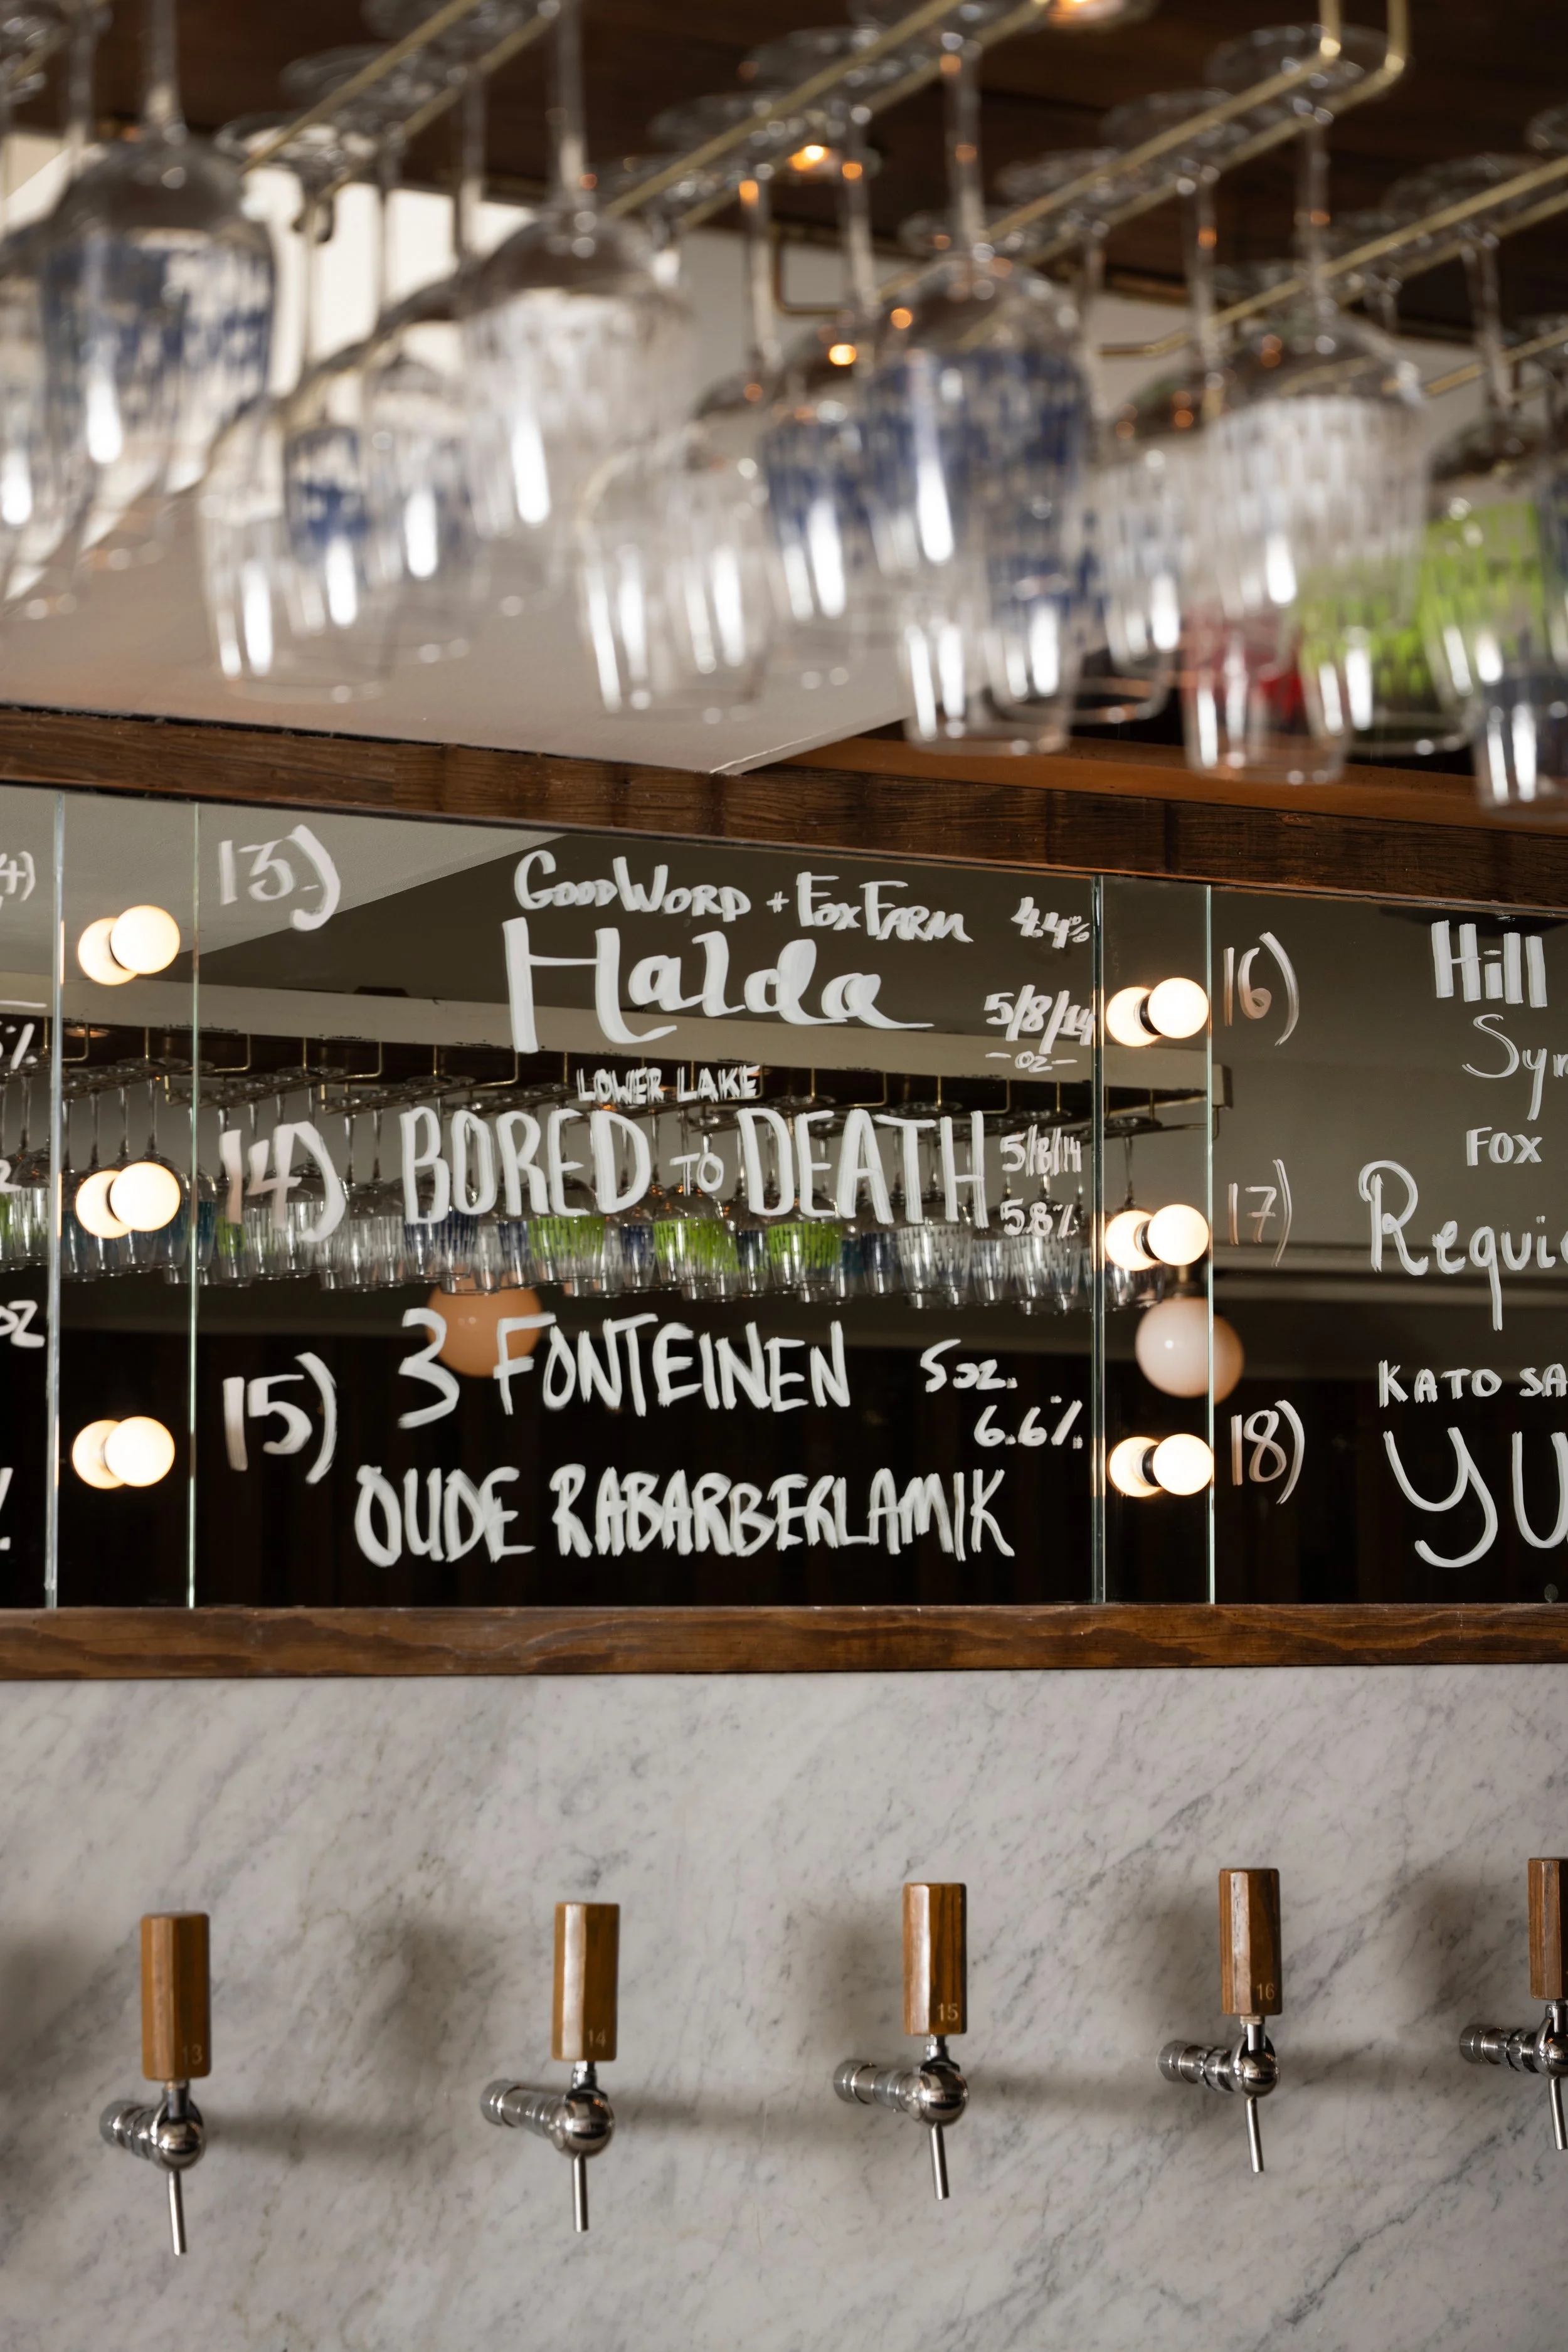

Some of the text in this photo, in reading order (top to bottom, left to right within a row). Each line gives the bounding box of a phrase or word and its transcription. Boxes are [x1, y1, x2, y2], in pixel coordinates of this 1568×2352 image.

[219, 825, 341, 931] 13)
[1223, 931, 1299, 1046] 16)
[1431, 919, 1547, 1008] Hill
[576, 1066, 760, 1103] LOWER LAKE
[219, 1121, 346, 1242] 14)
[400, 1106, 989, 1228] BORED TO DEATH
[1466, 1127, 1542, 1166] FOX
[1229, 1159, 1292, 1267] 17)
[1359, 1160, 1568, 1331] Requi
[222, 1352, 337, 1484] 15)
[398, 1308, 850, 1429] 3 FONTEINEN
[1379, 1360, 1502, 1407] KATO
[973, 1396, 1083, 1449] 6.6%
[1230, 1400, 1305, 1505] 18)
[354, 1465, 536, 1567] OUDE
[588, 2029, 606, 2048] 14
[938, 2003, 958, 2021] 15
[1257, 1983, 1274, 2001] 16
[183, 2043, 203, 2065] 13
